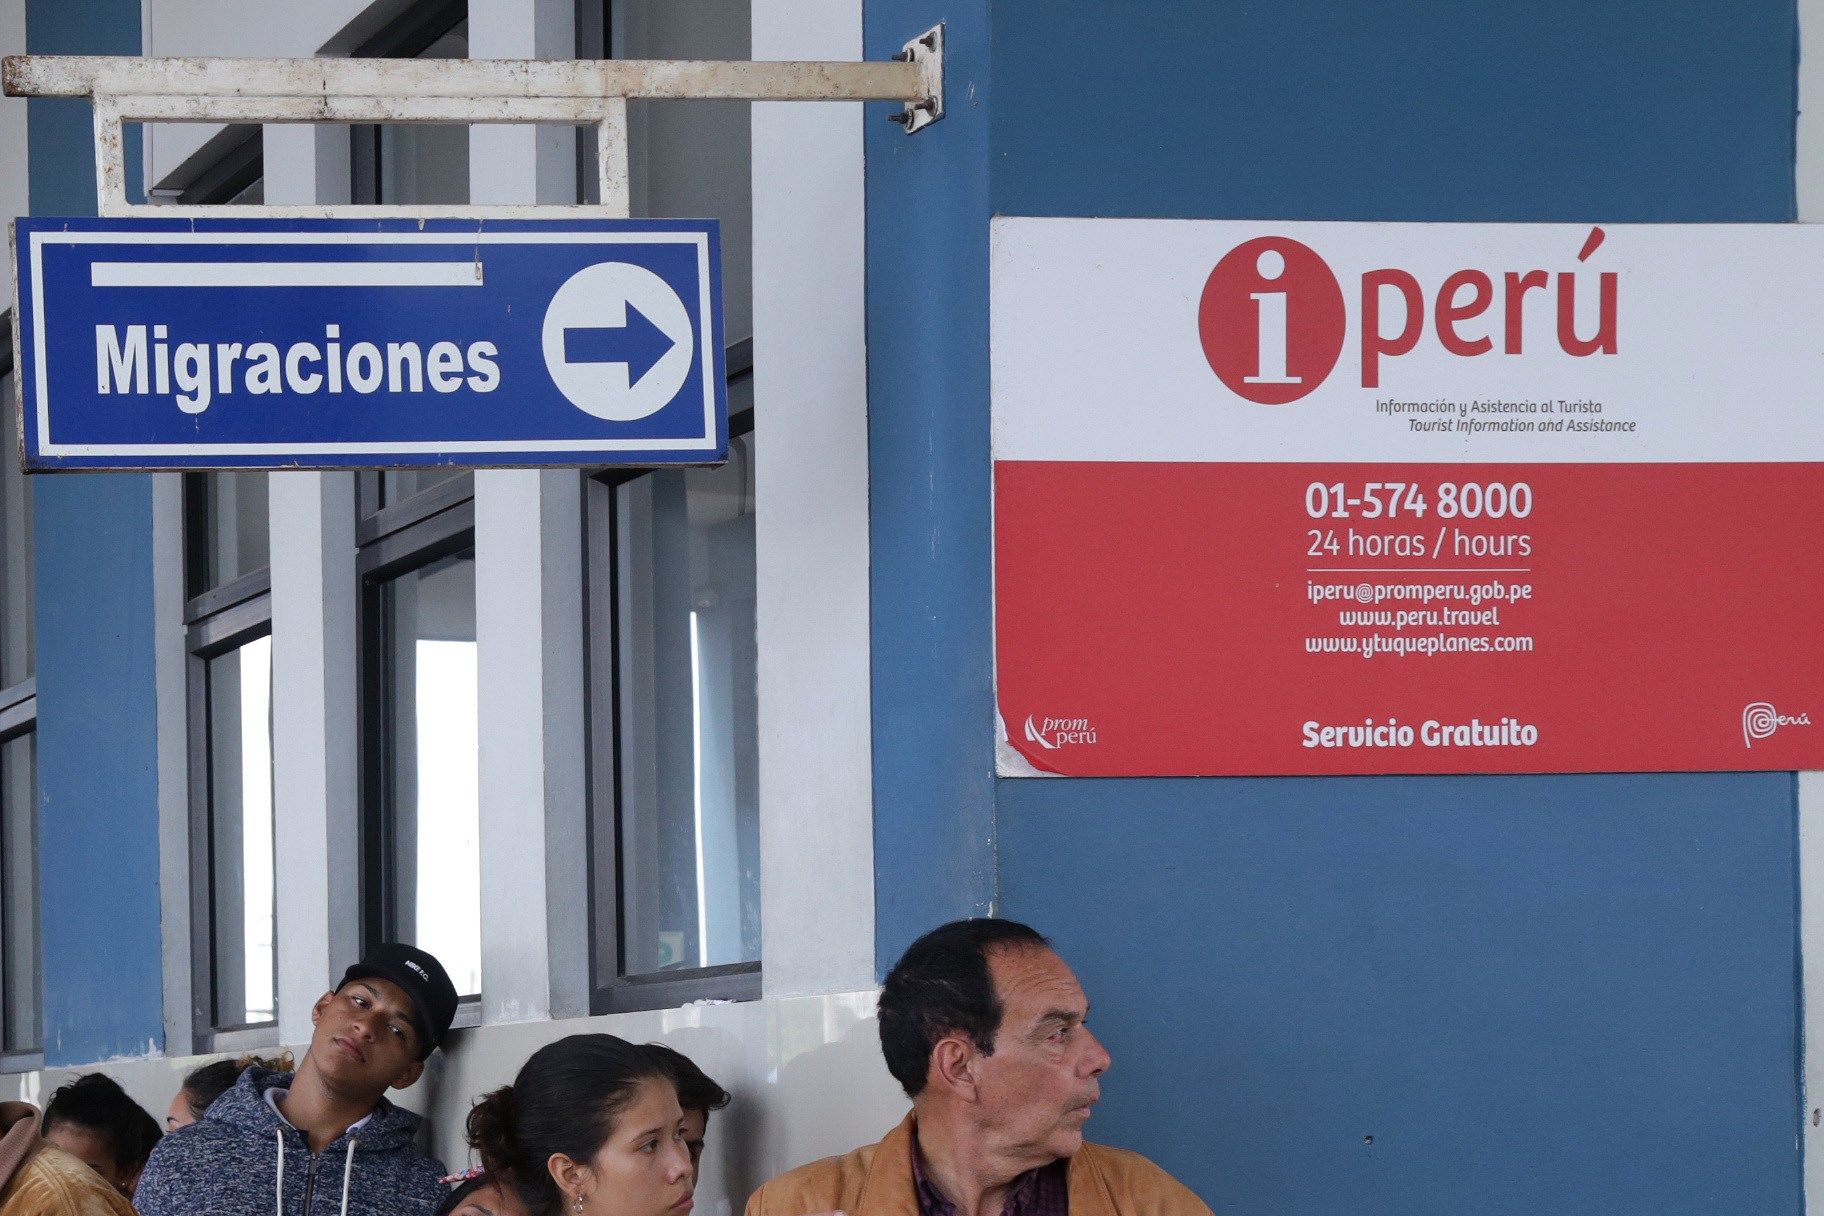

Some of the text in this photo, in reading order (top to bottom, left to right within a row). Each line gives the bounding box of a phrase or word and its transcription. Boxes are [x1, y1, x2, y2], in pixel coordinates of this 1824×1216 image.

[1243, 226, 1618, 388] i perú
[95, 324, 501, 414] Migraciones
[1375, 398, 1603, 418] Información y Asistencia al Turista
[1408, 418, 1637, 436] Tourist Information and Assistance
[1305, 482, 1533, 519] 01-574 8000
[1307, 529, 1341, 556] 24
[1348, 528, 1426, 557] horas
[1454, 528, 1532, 557] hours
[1307, 580, 1532, 606] iperu@promperu.gob.pe
[1339, 606, 1500, 631] www.peru.travel
[1305, 632, 1534, 659] www.ytuqueplanes.com
[1040, 717, 1088, 736] prom
[1056, 727, 1097, 748] perú
[1302, 717, 1539, 748] Servicio Gratuito
